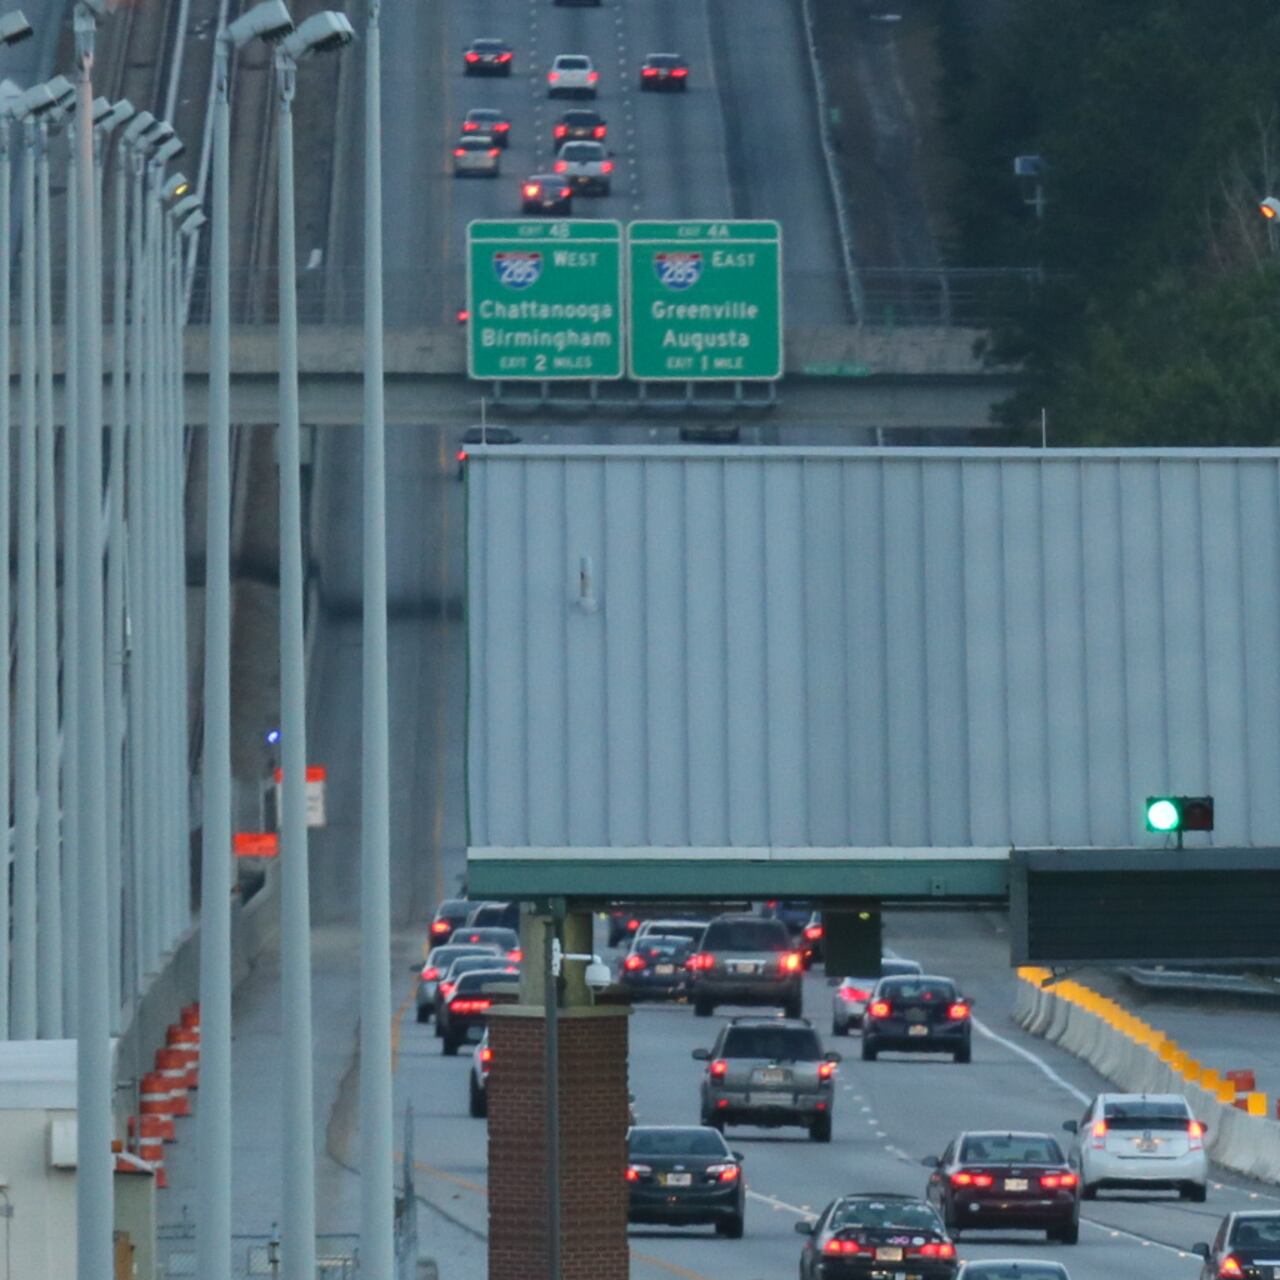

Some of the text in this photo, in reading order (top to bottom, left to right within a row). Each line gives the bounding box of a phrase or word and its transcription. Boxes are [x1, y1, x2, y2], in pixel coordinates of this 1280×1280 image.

[549, 223, 570, 238] 4B
[706, 224, 730, 237] 4A
[552, 250, 599, 267] WEST
[712, 251, 756, 267] EAST
[500, 260, 539, 283] 285
[661, 260, 699, 283] 285
[479, 299, 613, 322] Chattanooga
[651, 300, 759, 319] Greenville
[481, 328, 612, 352] Birmingham
[662, 329, 750, 352] Augusta
[499, 354, 593, 371] EXIT 2 MILES
[665, 355, 745, 371] EXIT 1 MILE
